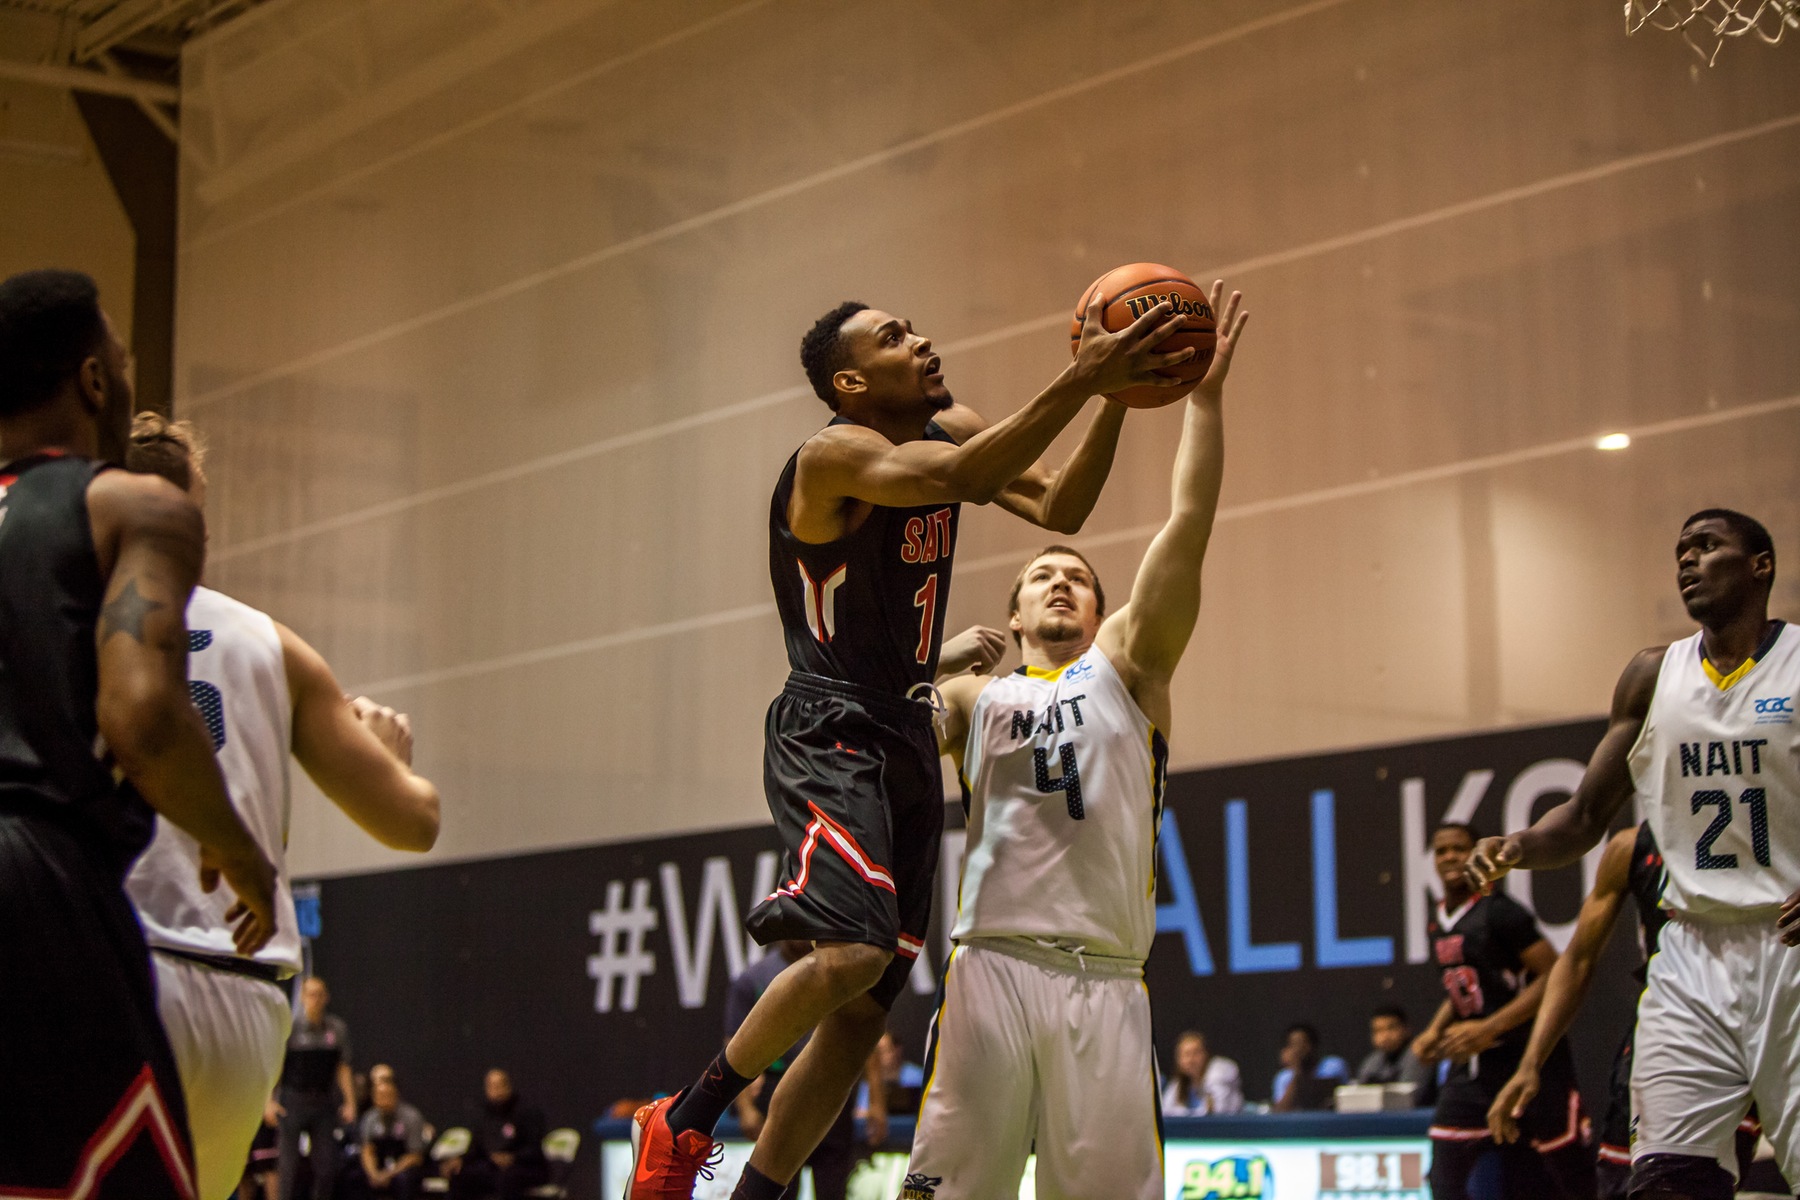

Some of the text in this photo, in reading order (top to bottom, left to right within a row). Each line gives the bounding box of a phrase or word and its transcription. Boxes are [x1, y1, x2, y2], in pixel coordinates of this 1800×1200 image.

[913, 573, 938, 665] 1
[1011, 694, 1086, 740] NAIT
[1034, 741, 1086, 820] 4
[1680, 738, 1768, 778] NAIT
[1690, 787, 1771, 870] 21
[1184, 1155, 1268, 1200] 94.1
